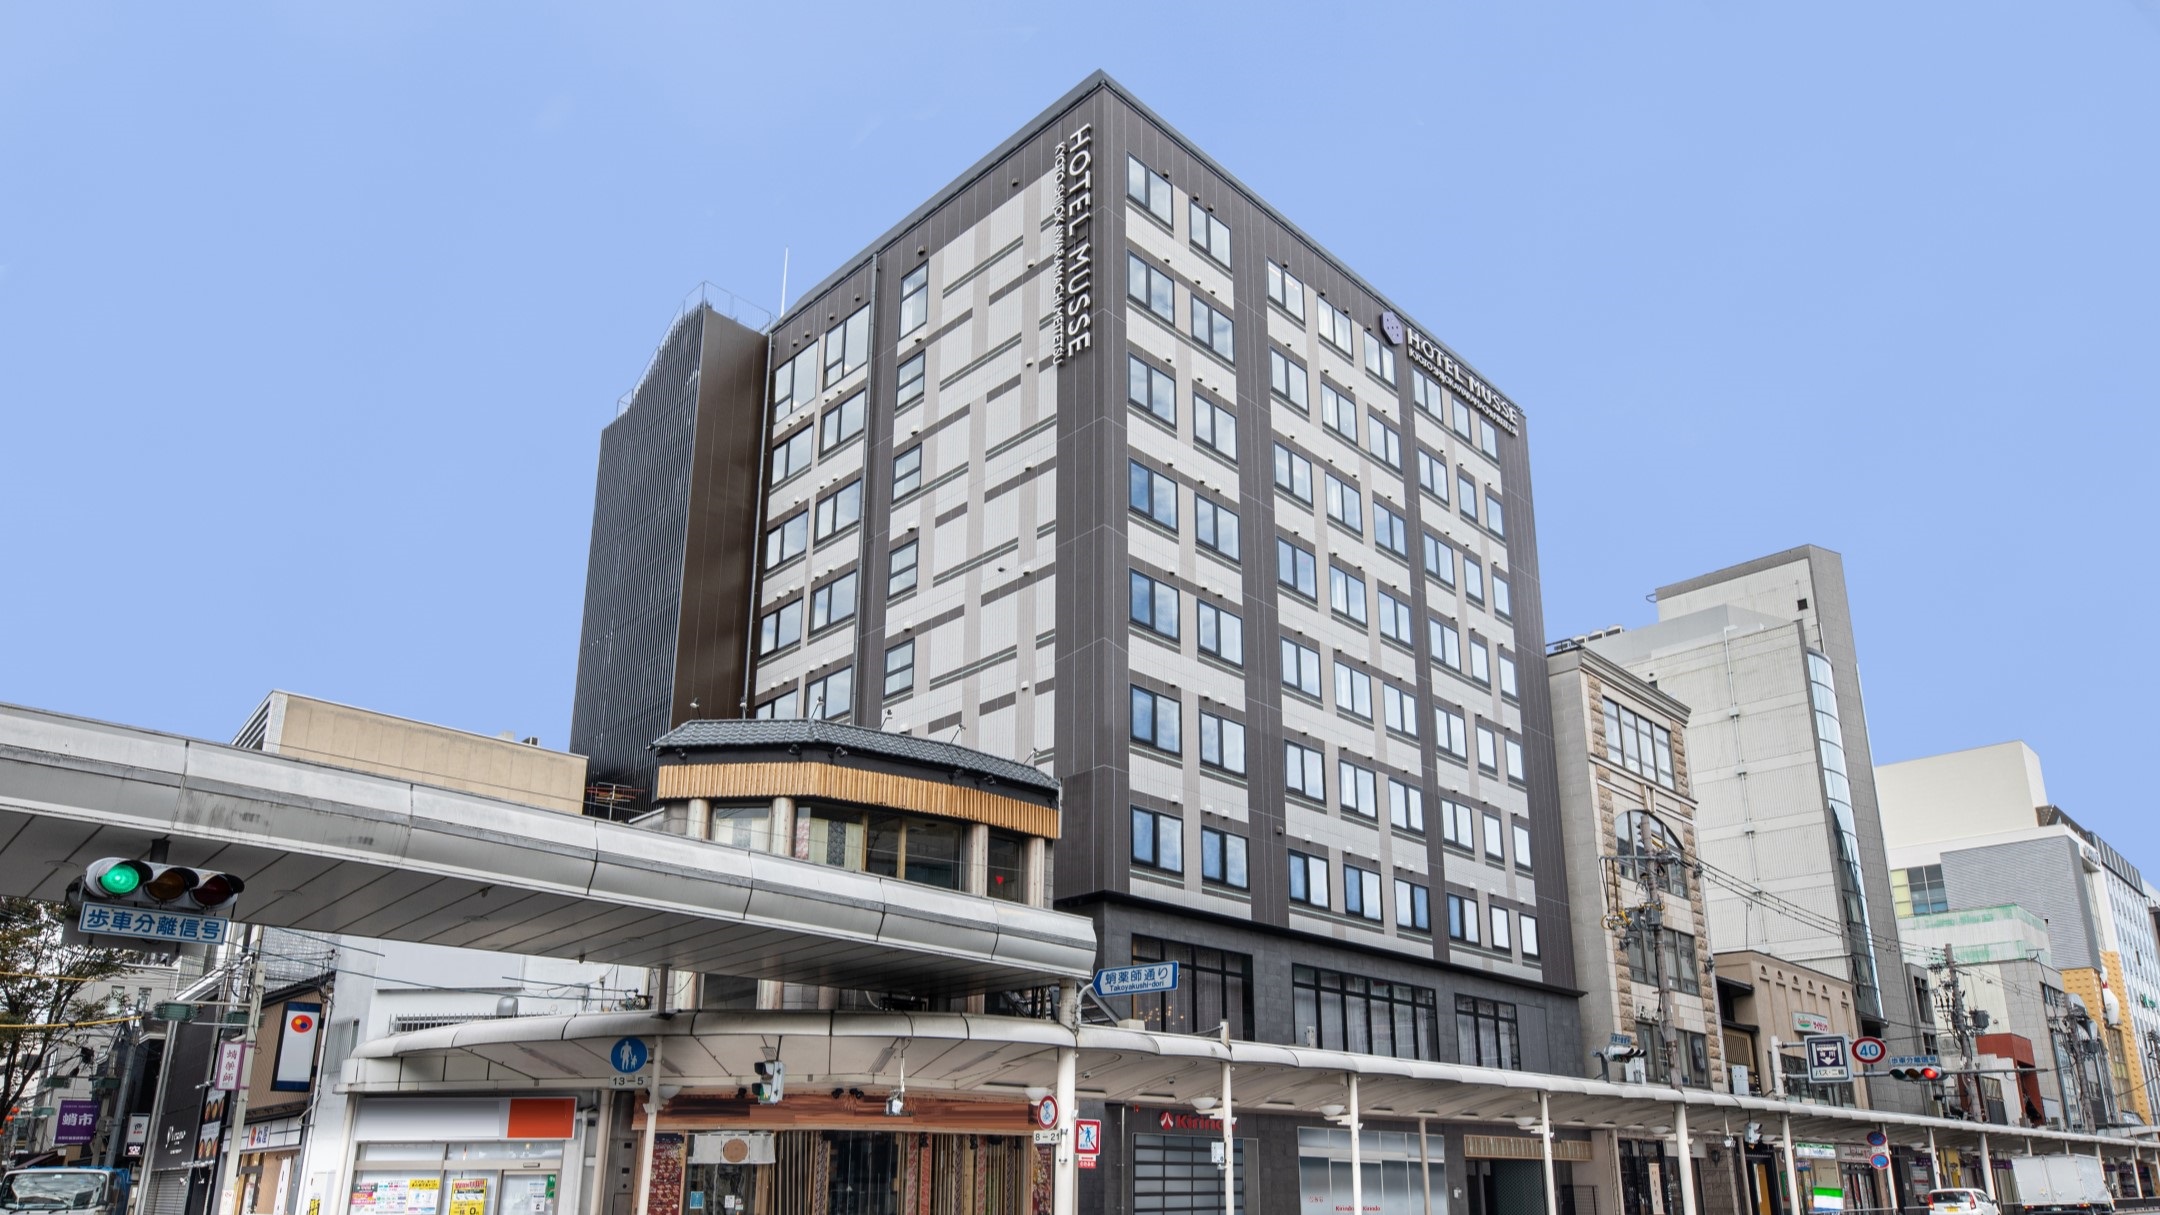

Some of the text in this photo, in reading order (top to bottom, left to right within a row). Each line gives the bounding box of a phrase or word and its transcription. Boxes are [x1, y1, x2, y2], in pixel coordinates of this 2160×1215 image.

[1053, 141, 1068, 185] KYOTO
[1067, 122, 1092, 358] HOTEL MUSSE
[1407, 348, 1433, 371] KYOTO
[1407, 327, 1518, 426] HOTEL MUSSE
[86, 909, 221, 941] 歩車分離信号
[1104, 966, 1168, 986] 蛸薬師通り
[1109, 980, 1164, 993] Takoyakushi-dori
[1860, 1044, 1878, 1056] 40
[61, 1112, 94, 1127] 蛸市
[1175, 1114, 1238, 1131] Kirin
